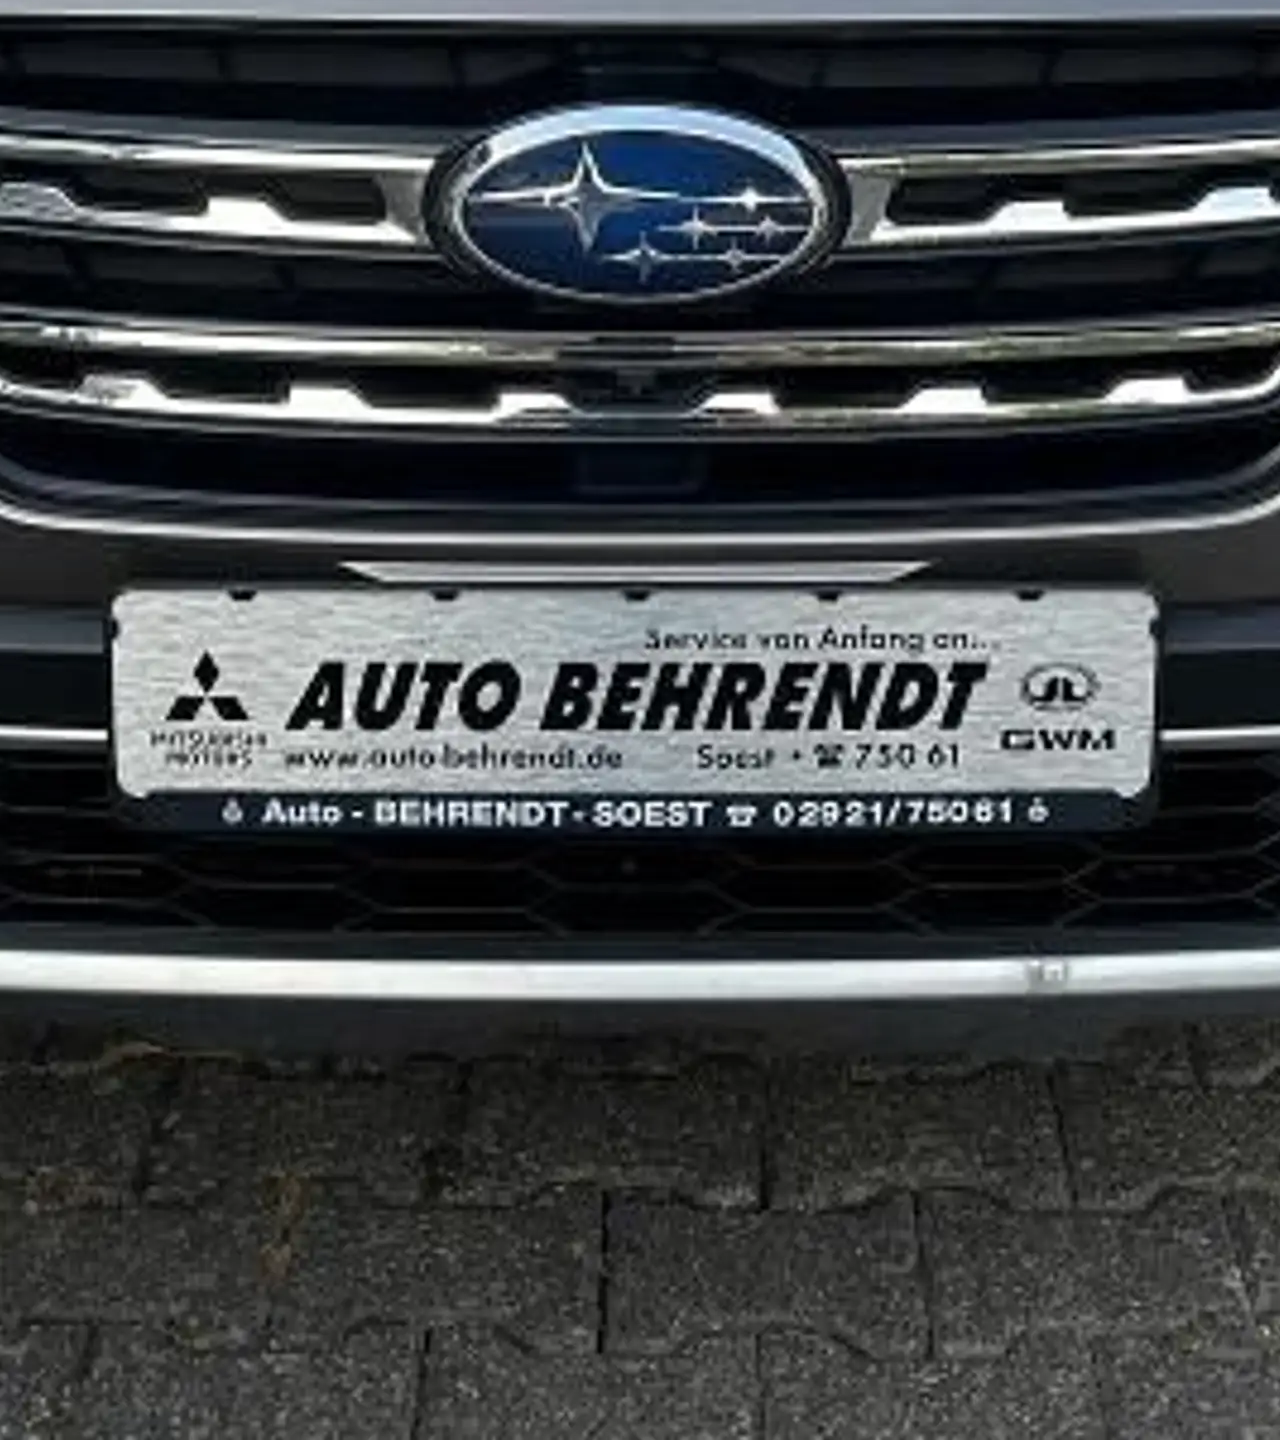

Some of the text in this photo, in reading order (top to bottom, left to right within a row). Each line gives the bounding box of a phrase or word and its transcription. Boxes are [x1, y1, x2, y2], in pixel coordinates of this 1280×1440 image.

[284, 660, 988, 732] AUTO BEHRENDT
[999, 728, 1117, 751] GWM
[855, 743, 917, 769] 750
[926, 743, 962, 768] 61
[261, 798, 344, 827] Auto
